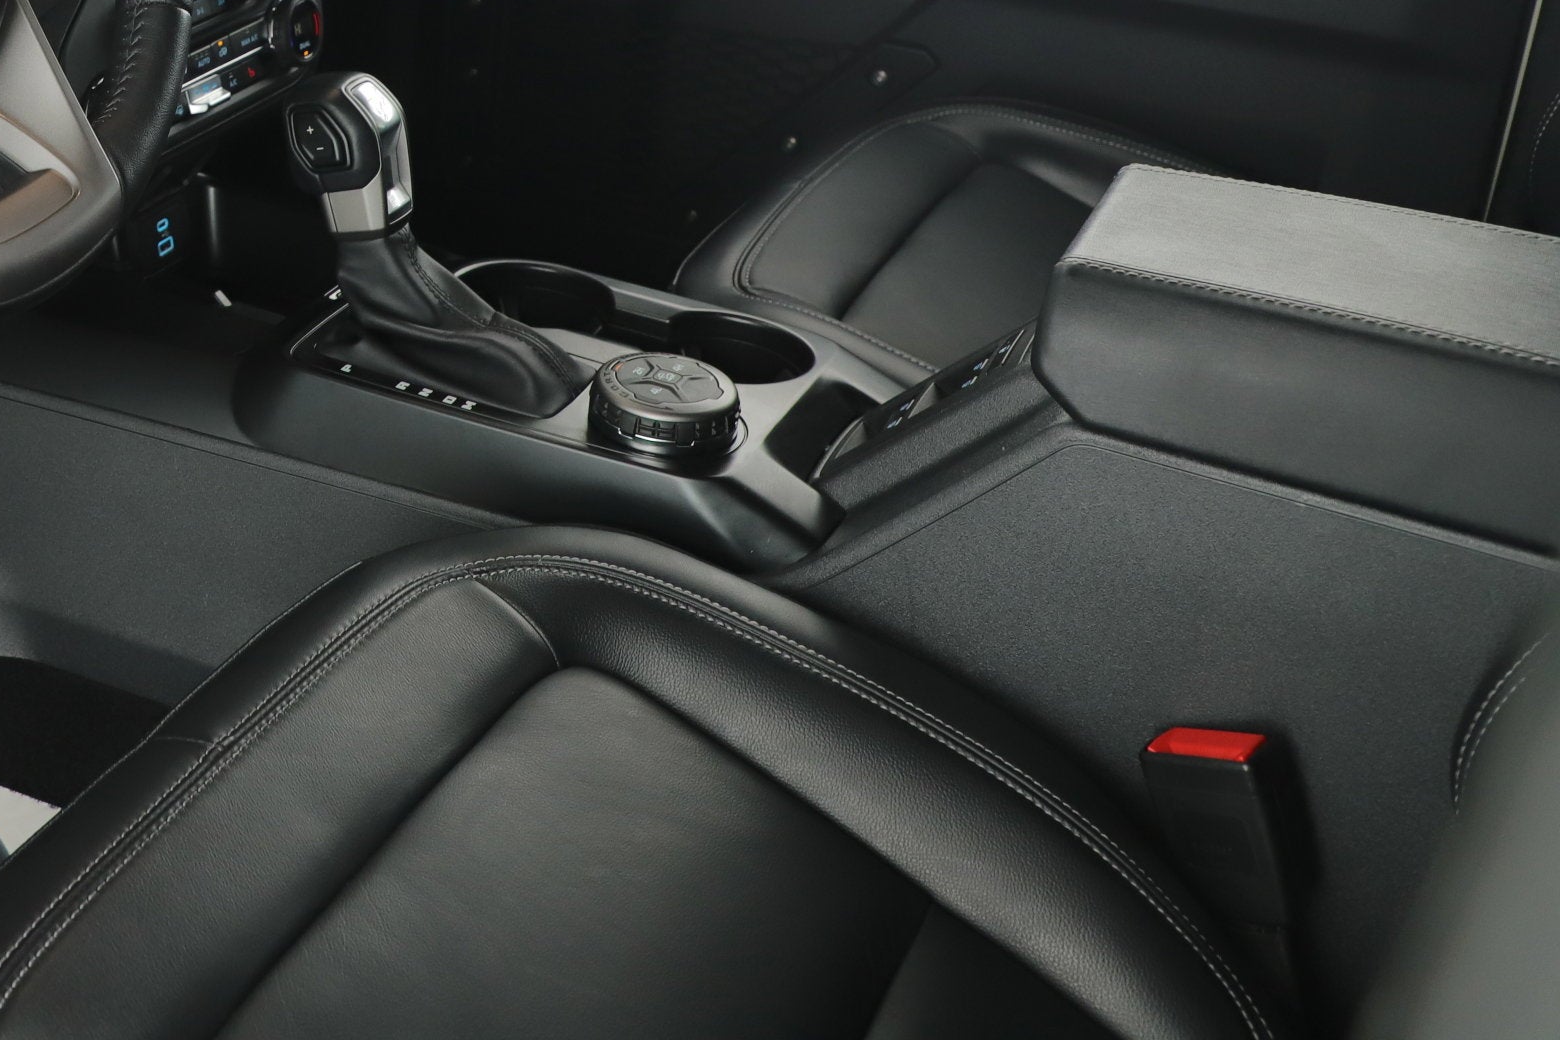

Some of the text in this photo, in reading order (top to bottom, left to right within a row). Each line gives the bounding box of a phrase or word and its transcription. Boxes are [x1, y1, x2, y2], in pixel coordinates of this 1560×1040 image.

[197, 56, 211, 68] AUTO
[340, 364, 352, 373] P
[442, 395, 457, 405] D
